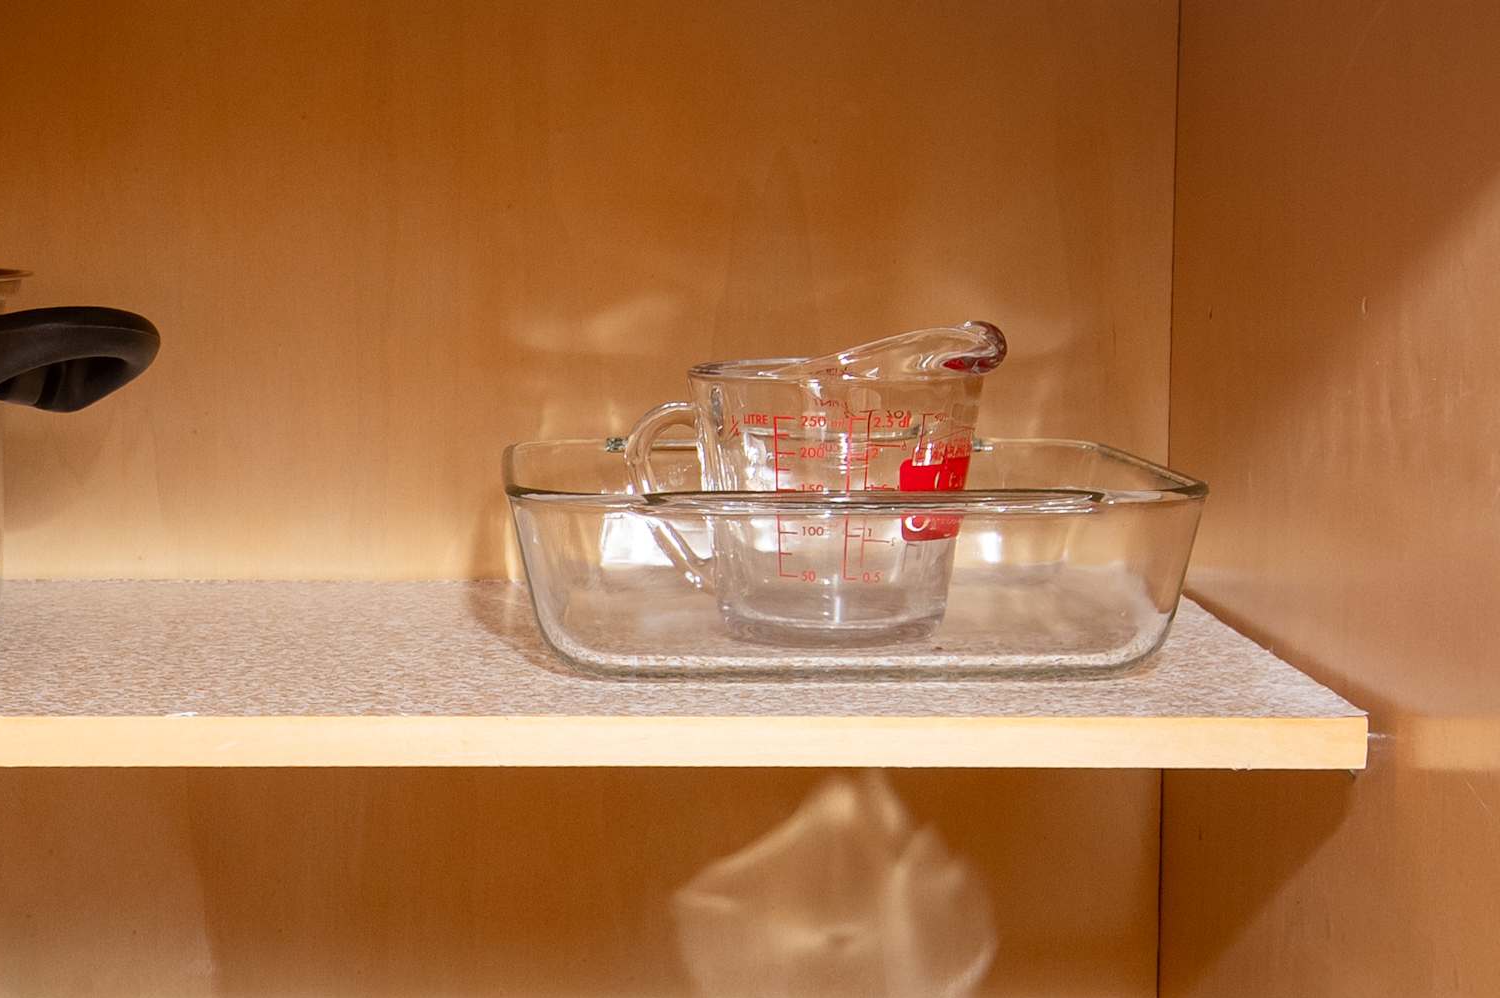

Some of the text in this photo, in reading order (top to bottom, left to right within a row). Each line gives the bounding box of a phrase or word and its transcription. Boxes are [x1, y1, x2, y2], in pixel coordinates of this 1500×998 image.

[743, 414, 768, 425] LITRE
[800, 416, 827, 428] 250
[800, 447, 825, 458] 200
[801, 526, 824, 537] 100
[802, 571, 817, 582] 50
[862, 572, 881, 584] 0.5
